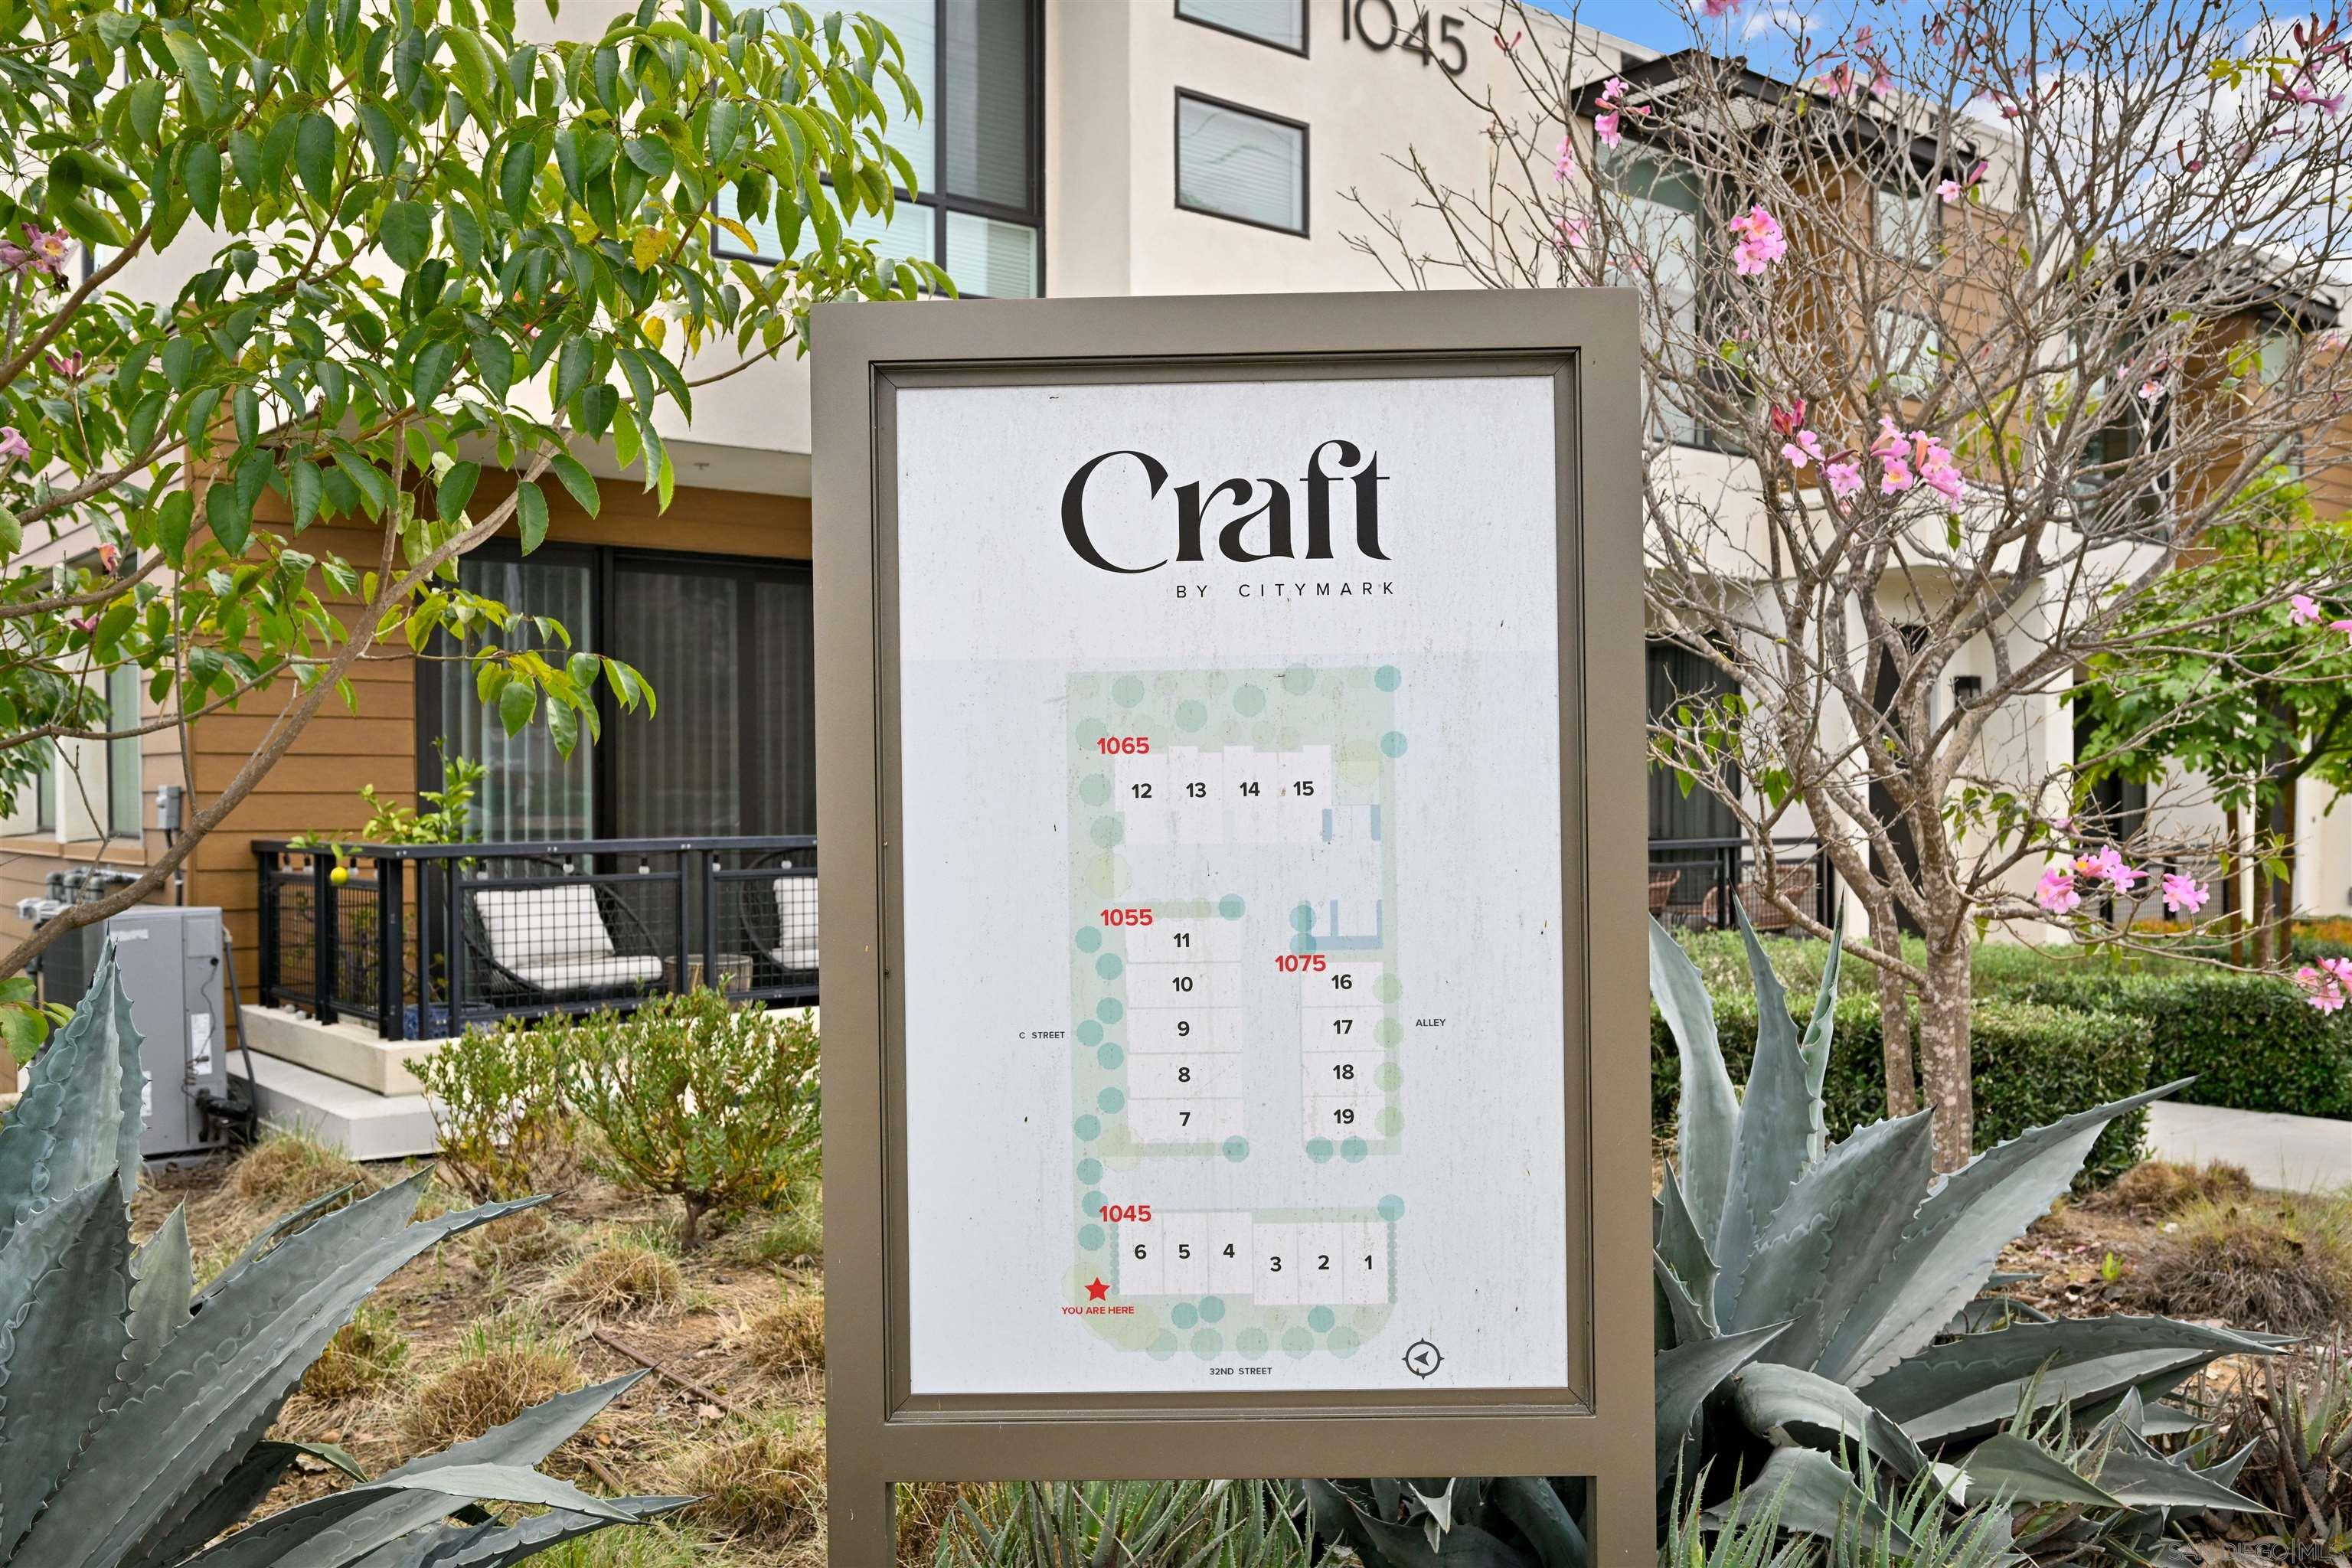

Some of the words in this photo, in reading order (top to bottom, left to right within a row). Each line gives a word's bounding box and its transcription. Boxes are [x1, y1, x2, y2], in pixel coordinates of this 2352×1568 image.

[1342, 0, 1468, 77] 1045
[1060, 439, 1393, 574] Craft
[1176, 584, 1207, 599] BY
[1238, 581, 1394, 597] CITYMARK
[1097, 737, 1150, 755] 1065
[1131, 782, 1152, 799] 12
[1185, 782, 1207, 799] 13
[1239, 781, 1261, 797] 14
[1292, 780, 1315, 796] 15
[1100, 908, 1153, 926] 1055
[1173, 933, 1190, 948] 11
[1275, 954, 1326, 972] 1075
[1171, 976, 1194, 992] 10
[1331, 973, 1353, 990] 16
[1177, 1021, 1191, 1037] 9
[1332, 1019, 1354, 1035] 17
[1415, 1018, 1446, 1027] ALLEY
[1018, 1031, 1027, 1040] C
[1031, 1031, 1066, 1040] STREET
[1178, 1067, 1191, 1083] 8
[1332, 1063, 1354, 1080] 18
[1179, 1111, 1191, 1127] 7
[1333, 1108, 1355, 1125] 19
[1099, 1204, 1152, 1223] 1045
[1134, 1243, 1147, 1260] 6
[1178, 1243, 1191, 1259] 5
[1223, 1243, 1236, 1259] 4
[1269, 1256, 1282, 1272] 3
[1318, 1254, 1330, 1270] 2
[1364, 1254, 1373, 1270] 1
[1061, 1306, 1083, 1315] YOU
[1086, 1306, 1106, 1315] ARE
[1108, 1305, 1135, 1315] HERE
[1209, 1367, 1234, 1376] 32ND
[1238, 1366, 1272, 1376] STREET
